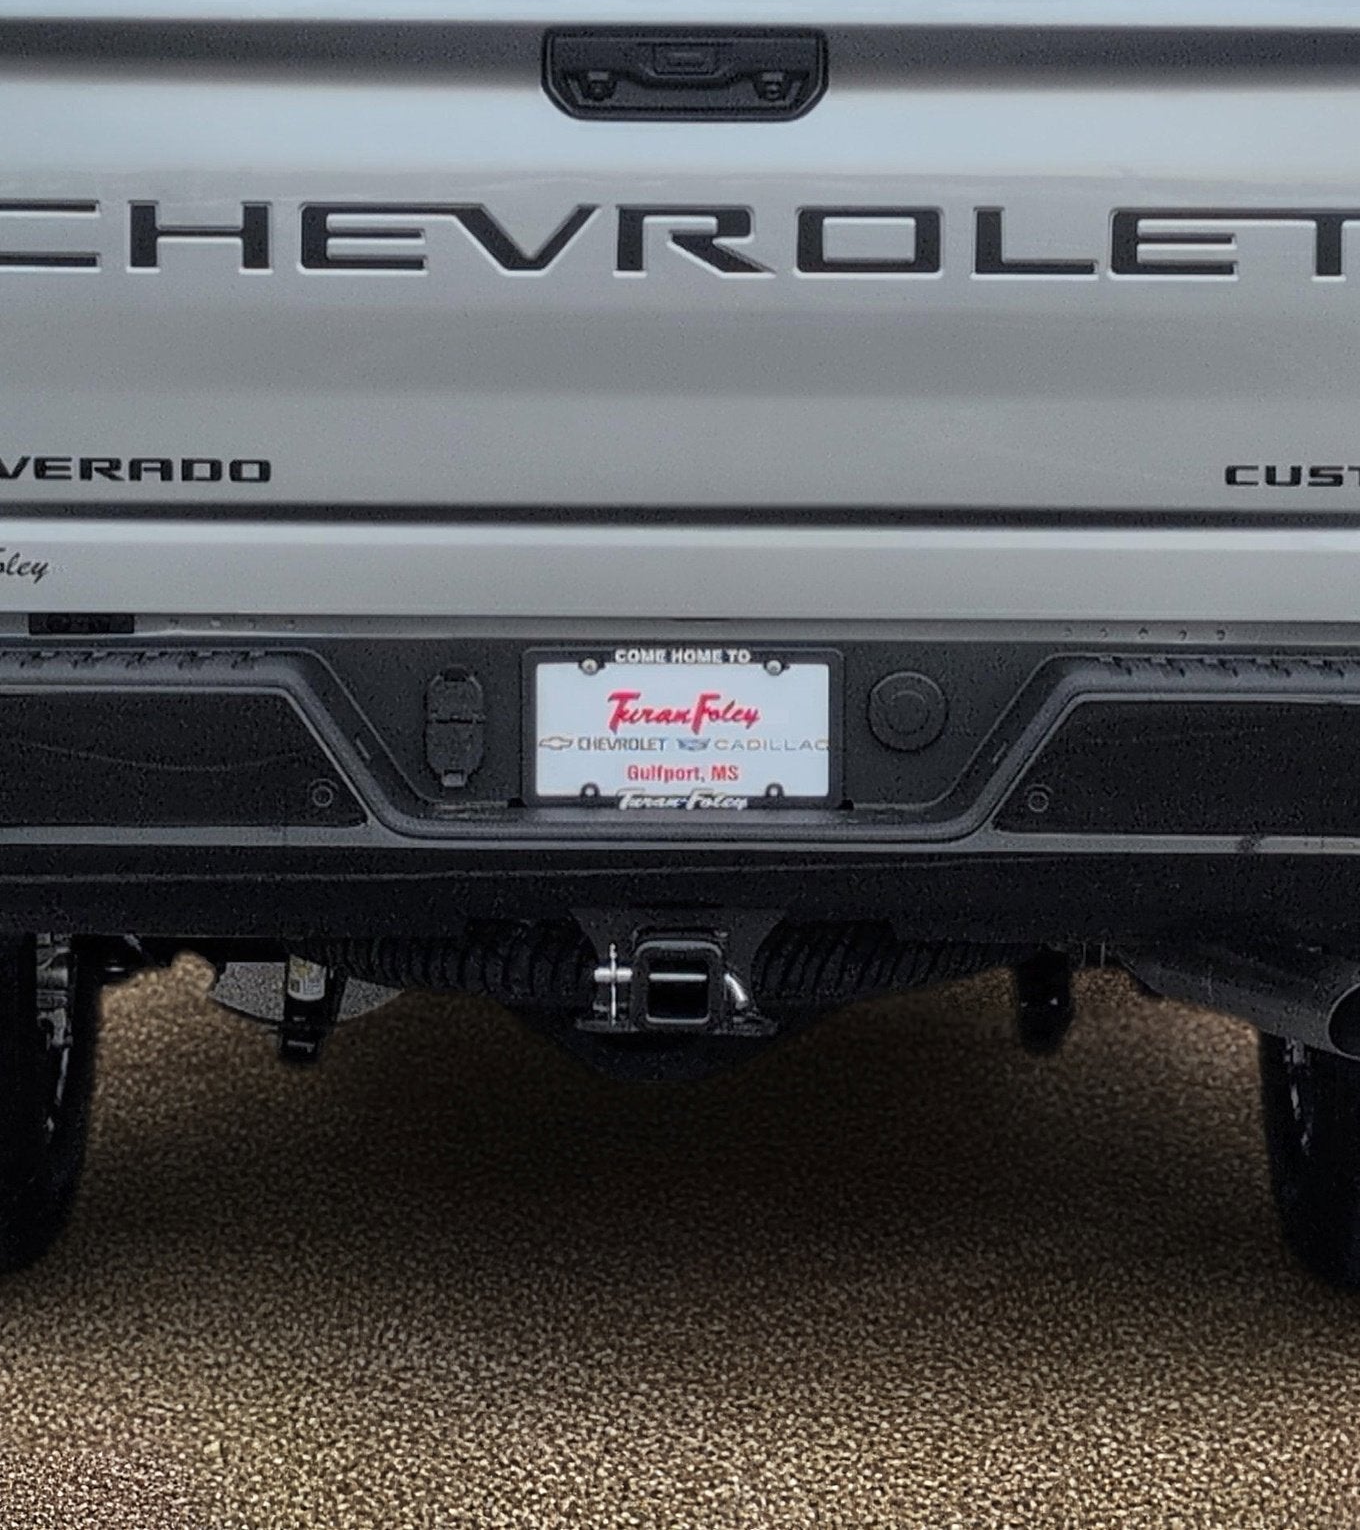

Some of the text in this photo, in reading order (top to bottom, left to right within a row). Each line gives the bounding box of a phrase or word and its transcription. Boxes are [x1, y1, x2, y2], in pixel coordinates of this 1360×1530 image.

[614, 648, 751, 664] COME HOME TO
[578, 736, 666, 751] CHEVROLET
[627, 764, 739, 784] Gulfport, MS
